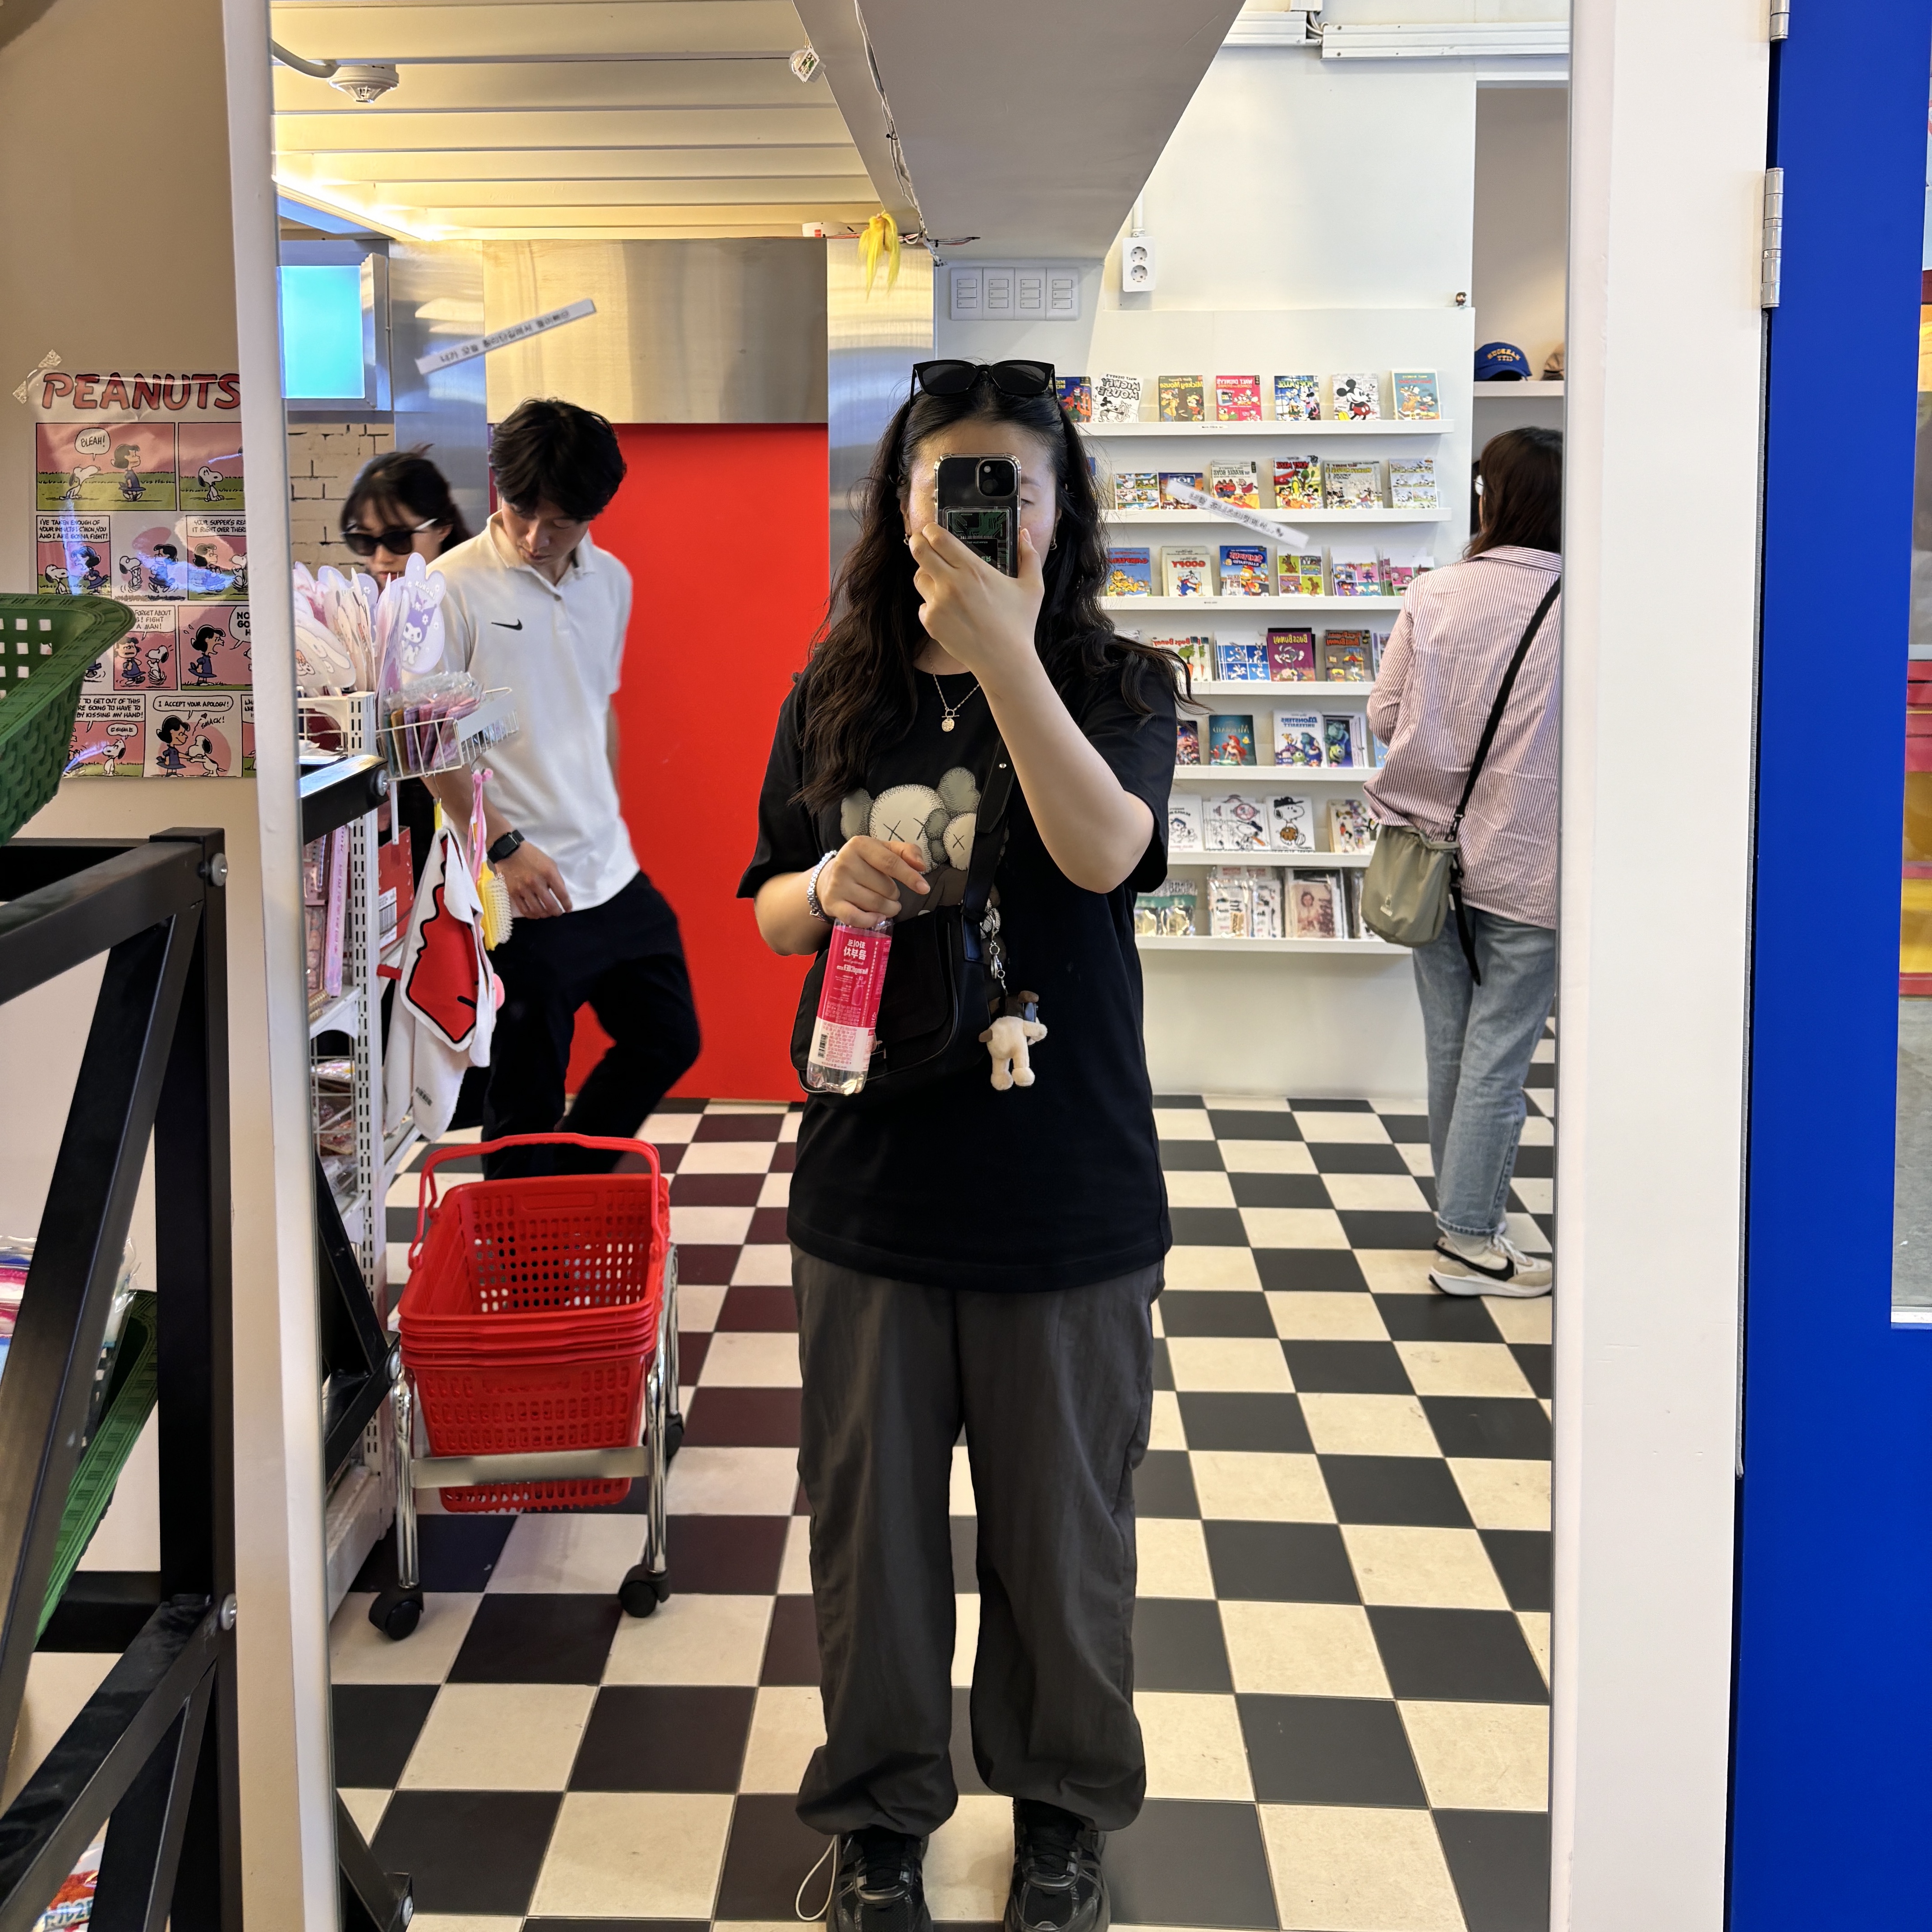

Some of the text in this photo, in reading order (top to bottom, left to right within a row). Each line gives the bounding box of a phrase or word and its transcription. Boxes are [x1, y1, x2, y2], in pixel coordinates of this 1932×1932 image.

[42, 372, 240, 410] PEANUTS
[81, 435, 105, 447] BLEAH!
[201, 716, 225, 729] SMACK!
